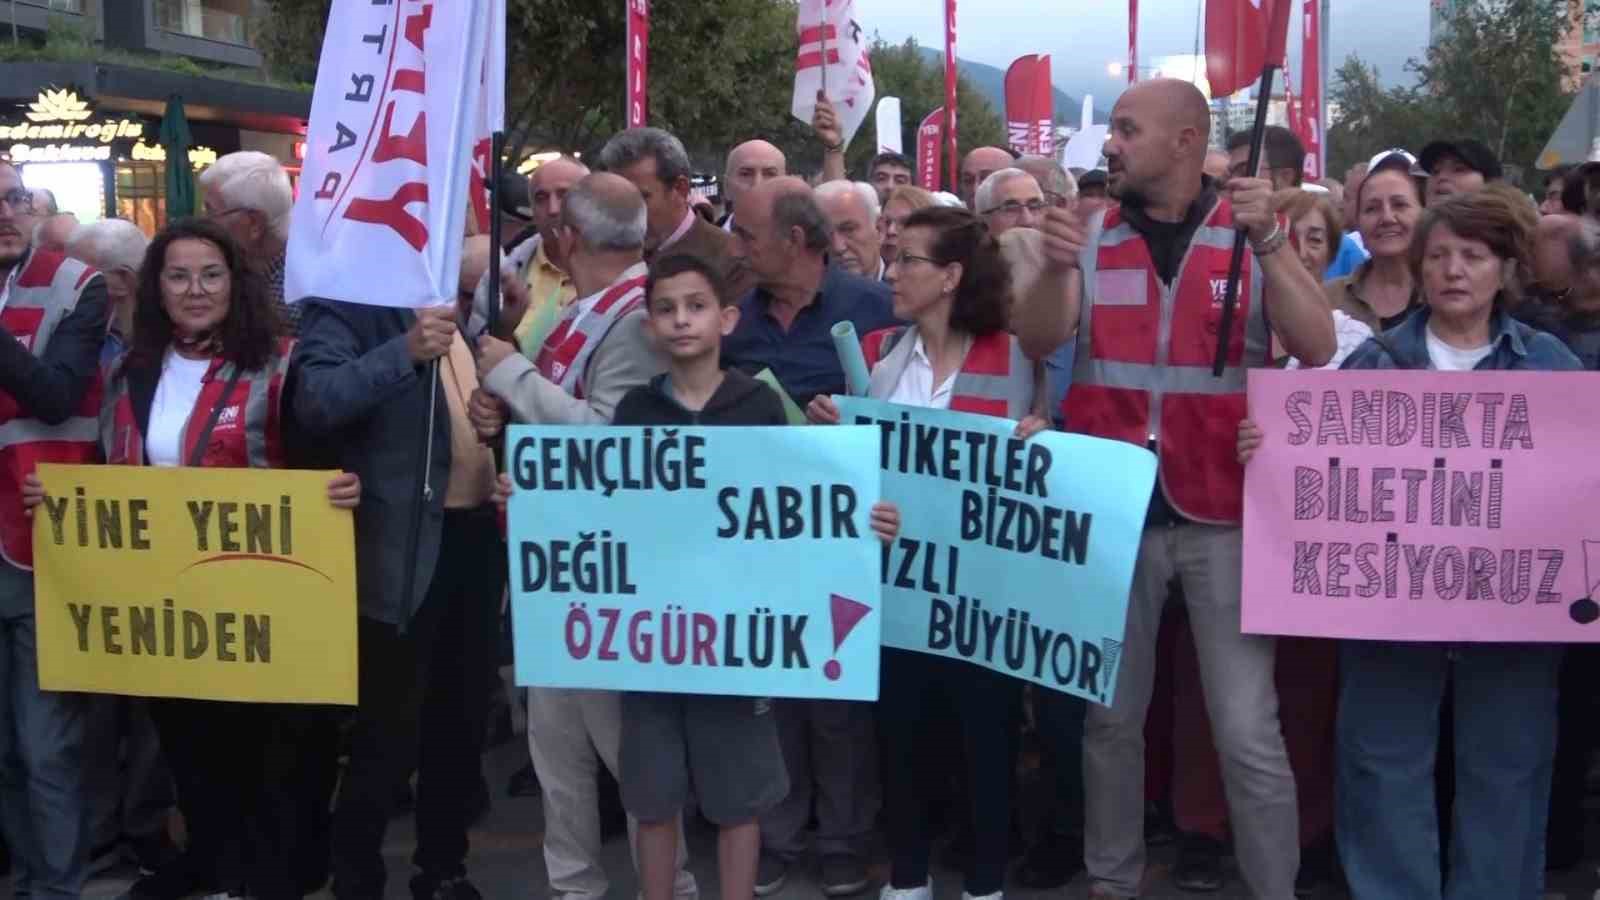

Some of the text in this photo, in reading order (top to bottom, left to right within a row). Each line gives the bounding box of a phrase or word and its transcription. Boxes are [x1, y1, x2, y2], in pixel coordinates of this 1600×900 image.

[1284, 389, 1534, 450] SANDIKTA
[513, 428, 707, 497] GENÇLİĞE
[855, 412, 1053, 498] TİKETLER
[42, 486, 293, 555] YİNE YENİ
[716, 484, 860, 540] SABIR
[960, 487, 1093, 566] BİZDEN
[1293, 457, 1504, 529] BİLETİNİ
[520, 530, 637, 595] DEĞİL
[67, 598, 272, 664] YENİDEN
